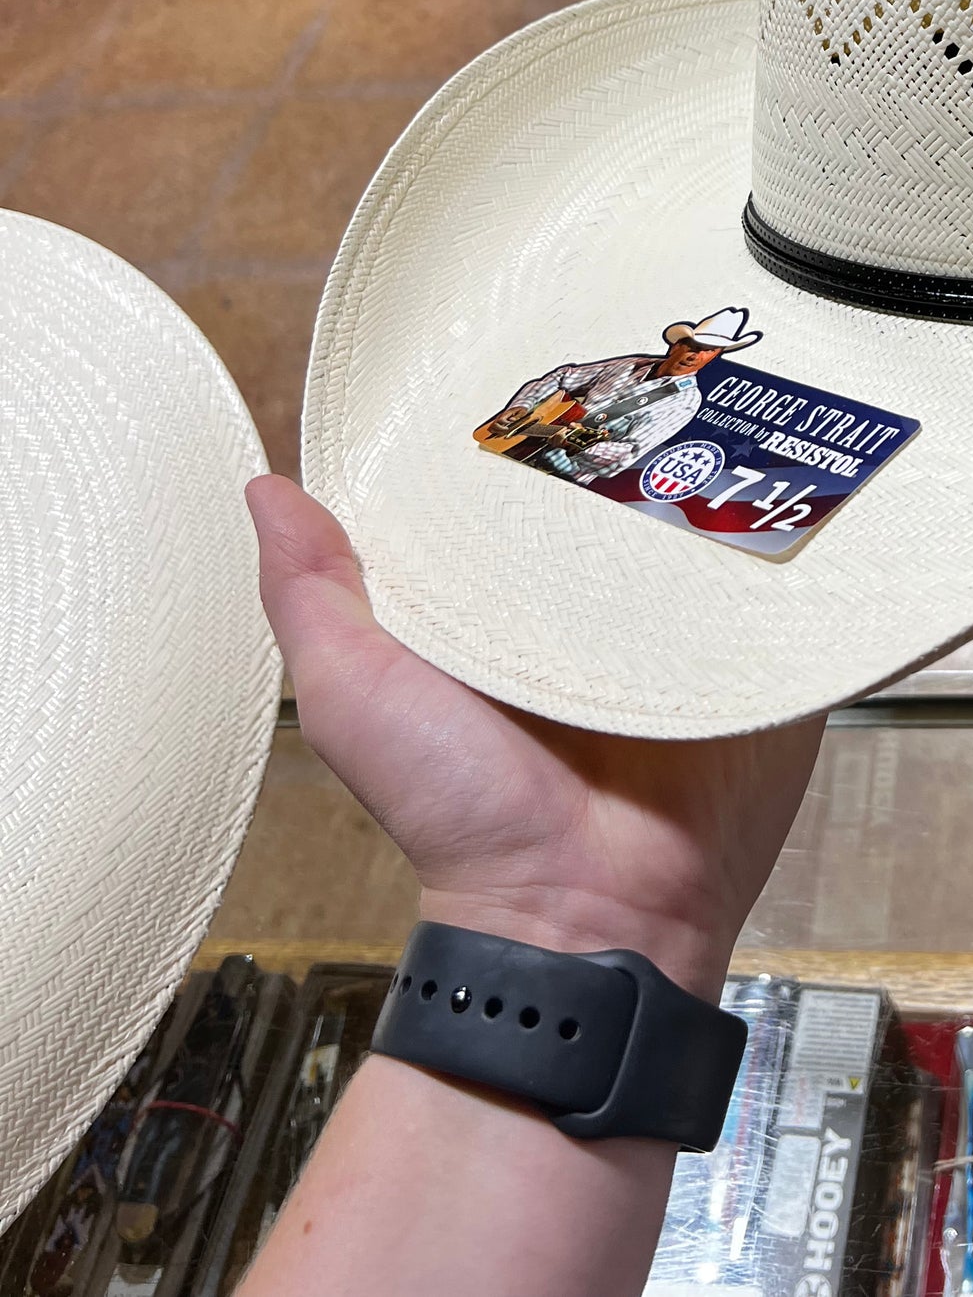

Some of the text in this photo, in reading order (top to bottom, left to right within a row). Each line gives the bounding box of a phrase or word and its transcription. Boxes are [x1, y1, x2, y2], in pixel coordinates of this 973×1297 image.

[696, 407, 864, 478] COLLECTION by RESISTOL
[706, 376, 900, 455] GEORGE STRAIT
[659, 457, 704, 485] USA
[706, 465, 767, 510] 7
[803, 1125, 852, 1271] HOOEY
